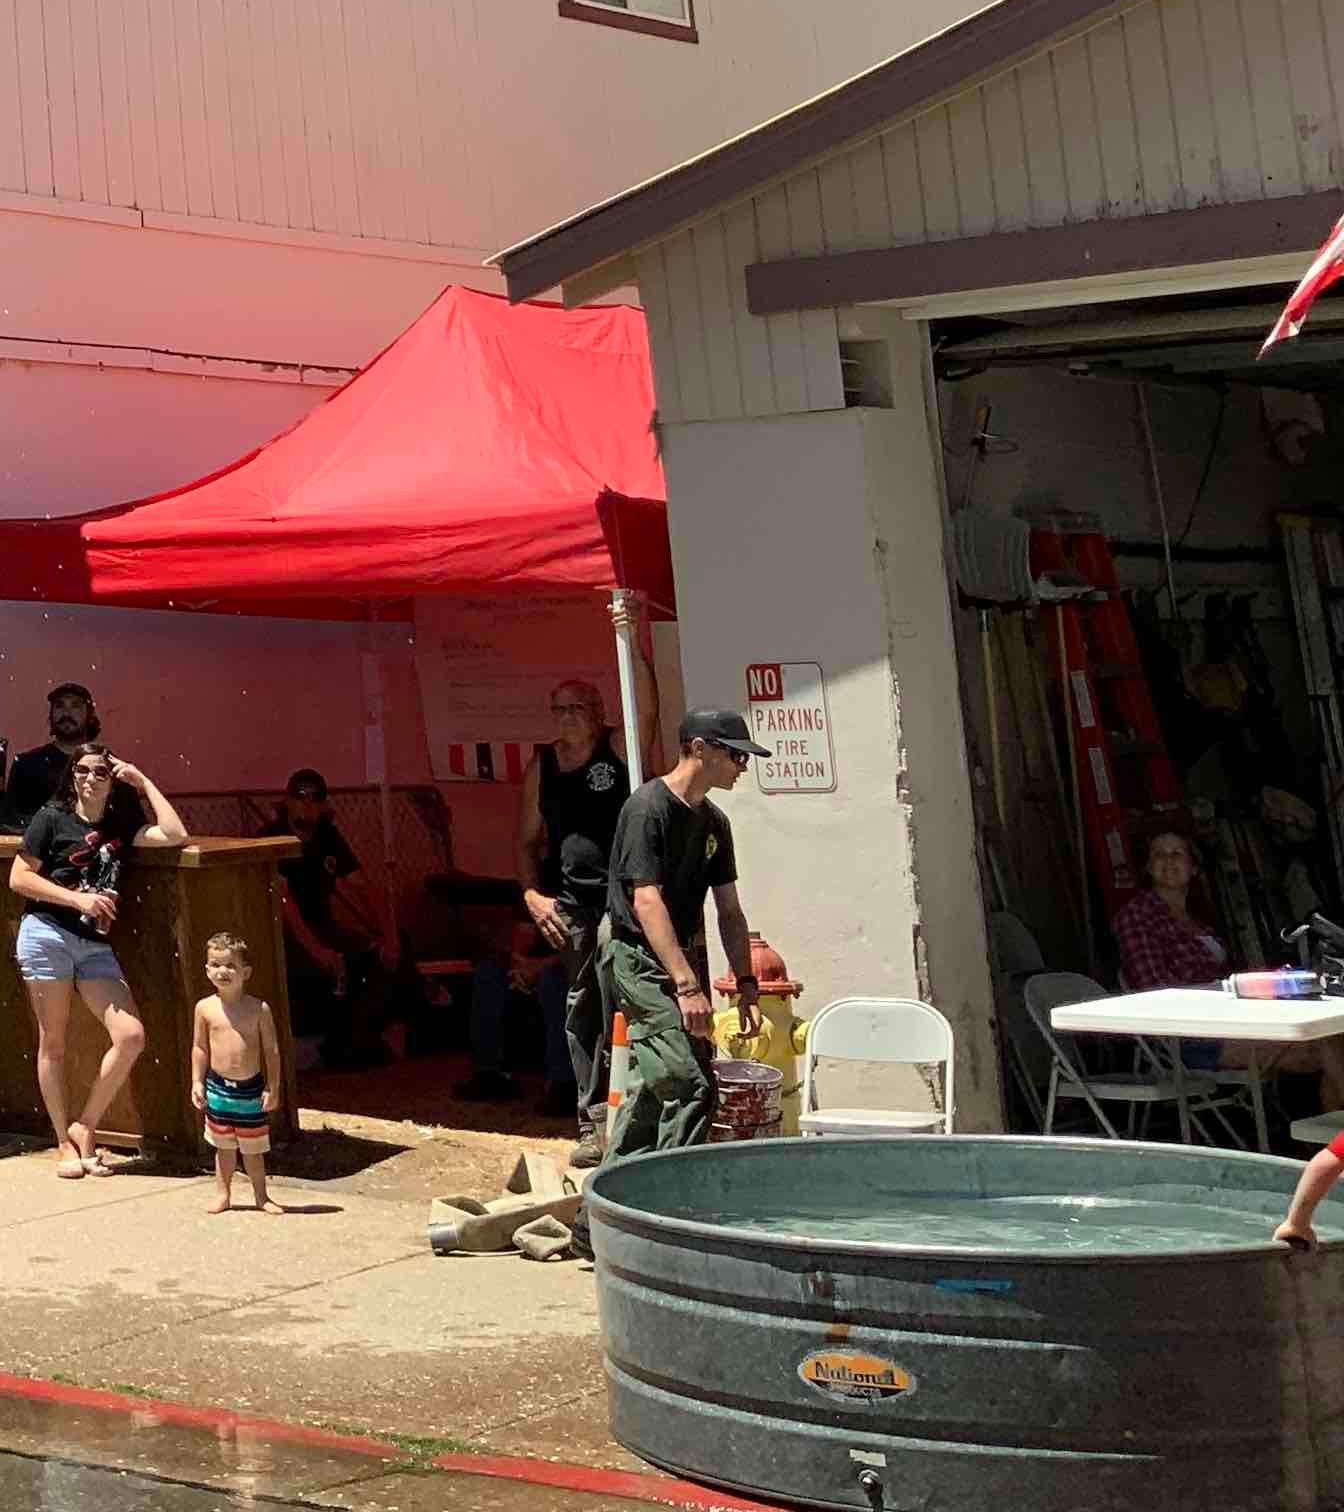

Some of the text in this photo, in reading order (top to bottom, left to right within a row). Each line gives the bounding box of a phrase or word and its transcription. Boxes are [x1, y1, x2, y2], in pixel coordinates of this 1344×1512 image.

[749, 668, 778, 697] NO
[756, 708, 824, 732] PARKING
[776, 739, 809, 756] FIRE
[766, 761, 825, 779] STATION
